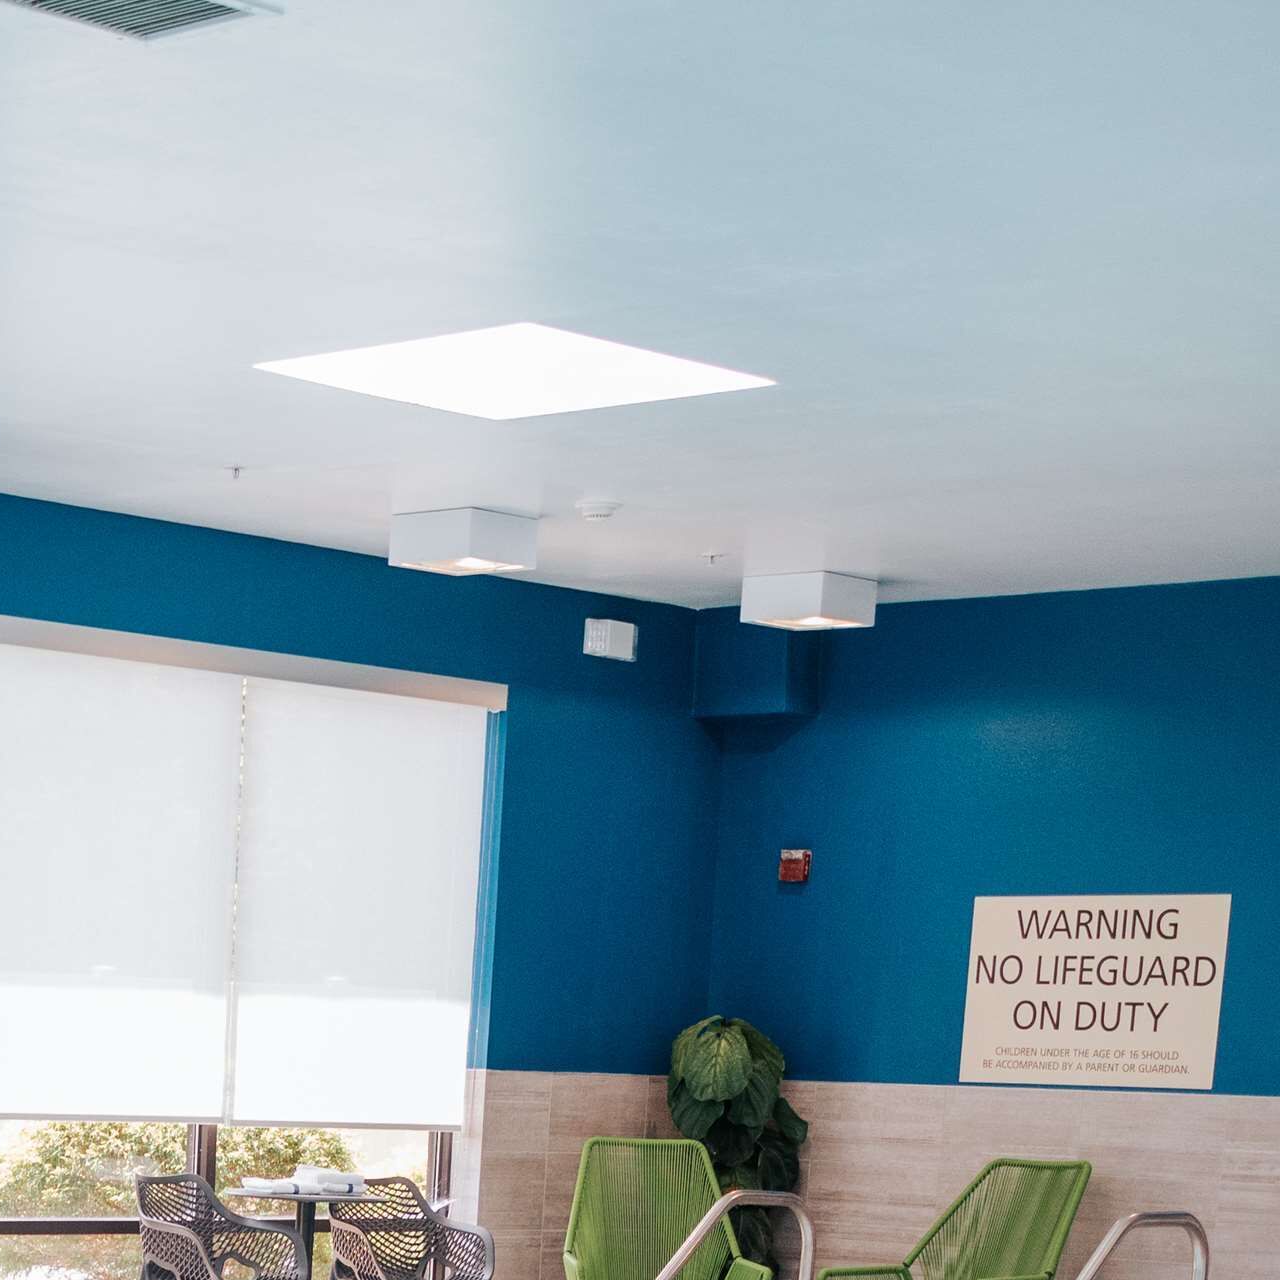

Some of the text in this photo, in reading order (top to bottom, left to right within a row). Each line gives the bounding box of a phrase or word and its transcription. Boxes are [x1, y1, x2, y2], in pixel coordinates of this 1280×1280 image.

[1017, 909, 1180, 940] WARNING
[975, 954, 1217, 987] NO LIFEGUARD
[1013, 1000, 1169, 1033] ON DUTY
[982, 1059, 1191, 1075] BE ACCOMPANIED BY A PARENT OR GUARDIAN.
[995, 1046, 1038, 1057] CHILDREN
[1040, 1047, 1070, 1058] UNDER
[1073, 1048, 1090, 1058] THE
[1092, 1049, 1111, 1059] AGE
[1113, 1049, 1126, 1060] OF
[1141, 1050, 1180, 1061] SHOULD
